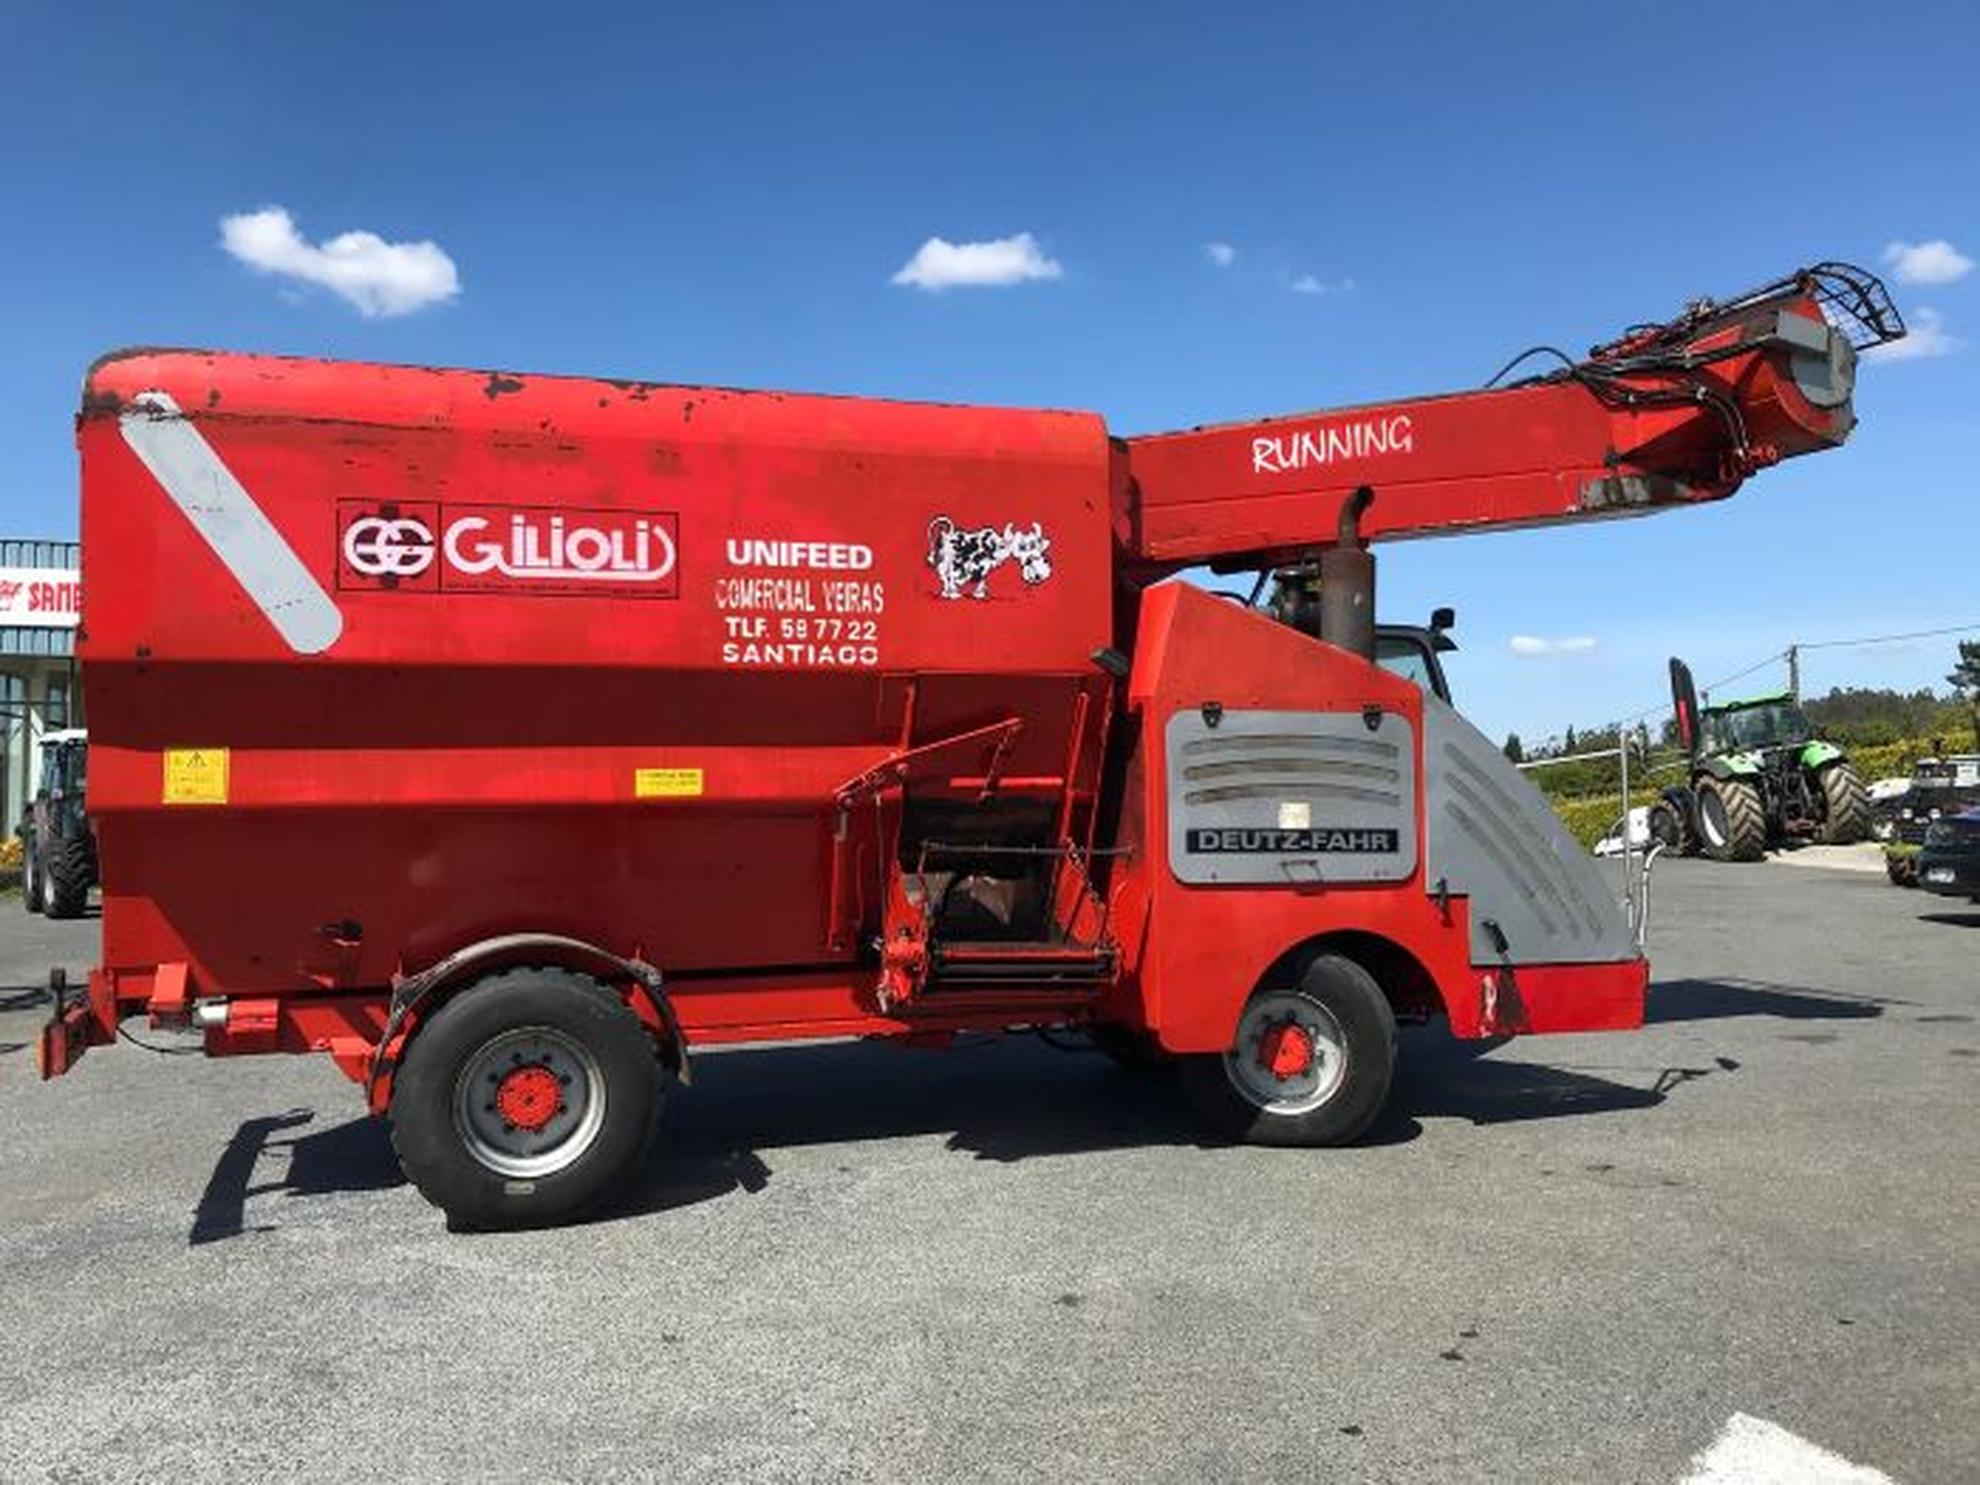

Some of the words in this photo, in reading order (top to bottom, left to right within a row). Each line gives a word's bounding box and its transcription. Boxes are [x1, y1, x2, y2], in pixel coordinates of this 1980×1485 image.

[1252, 415, 1412, 473] RUNNING
[727, 540, 873, 570] UNIFEED
[723, 643, 878, 665] SANTIAGO
[1200, 831, 1390, 850] DEUTZ-FAHR
